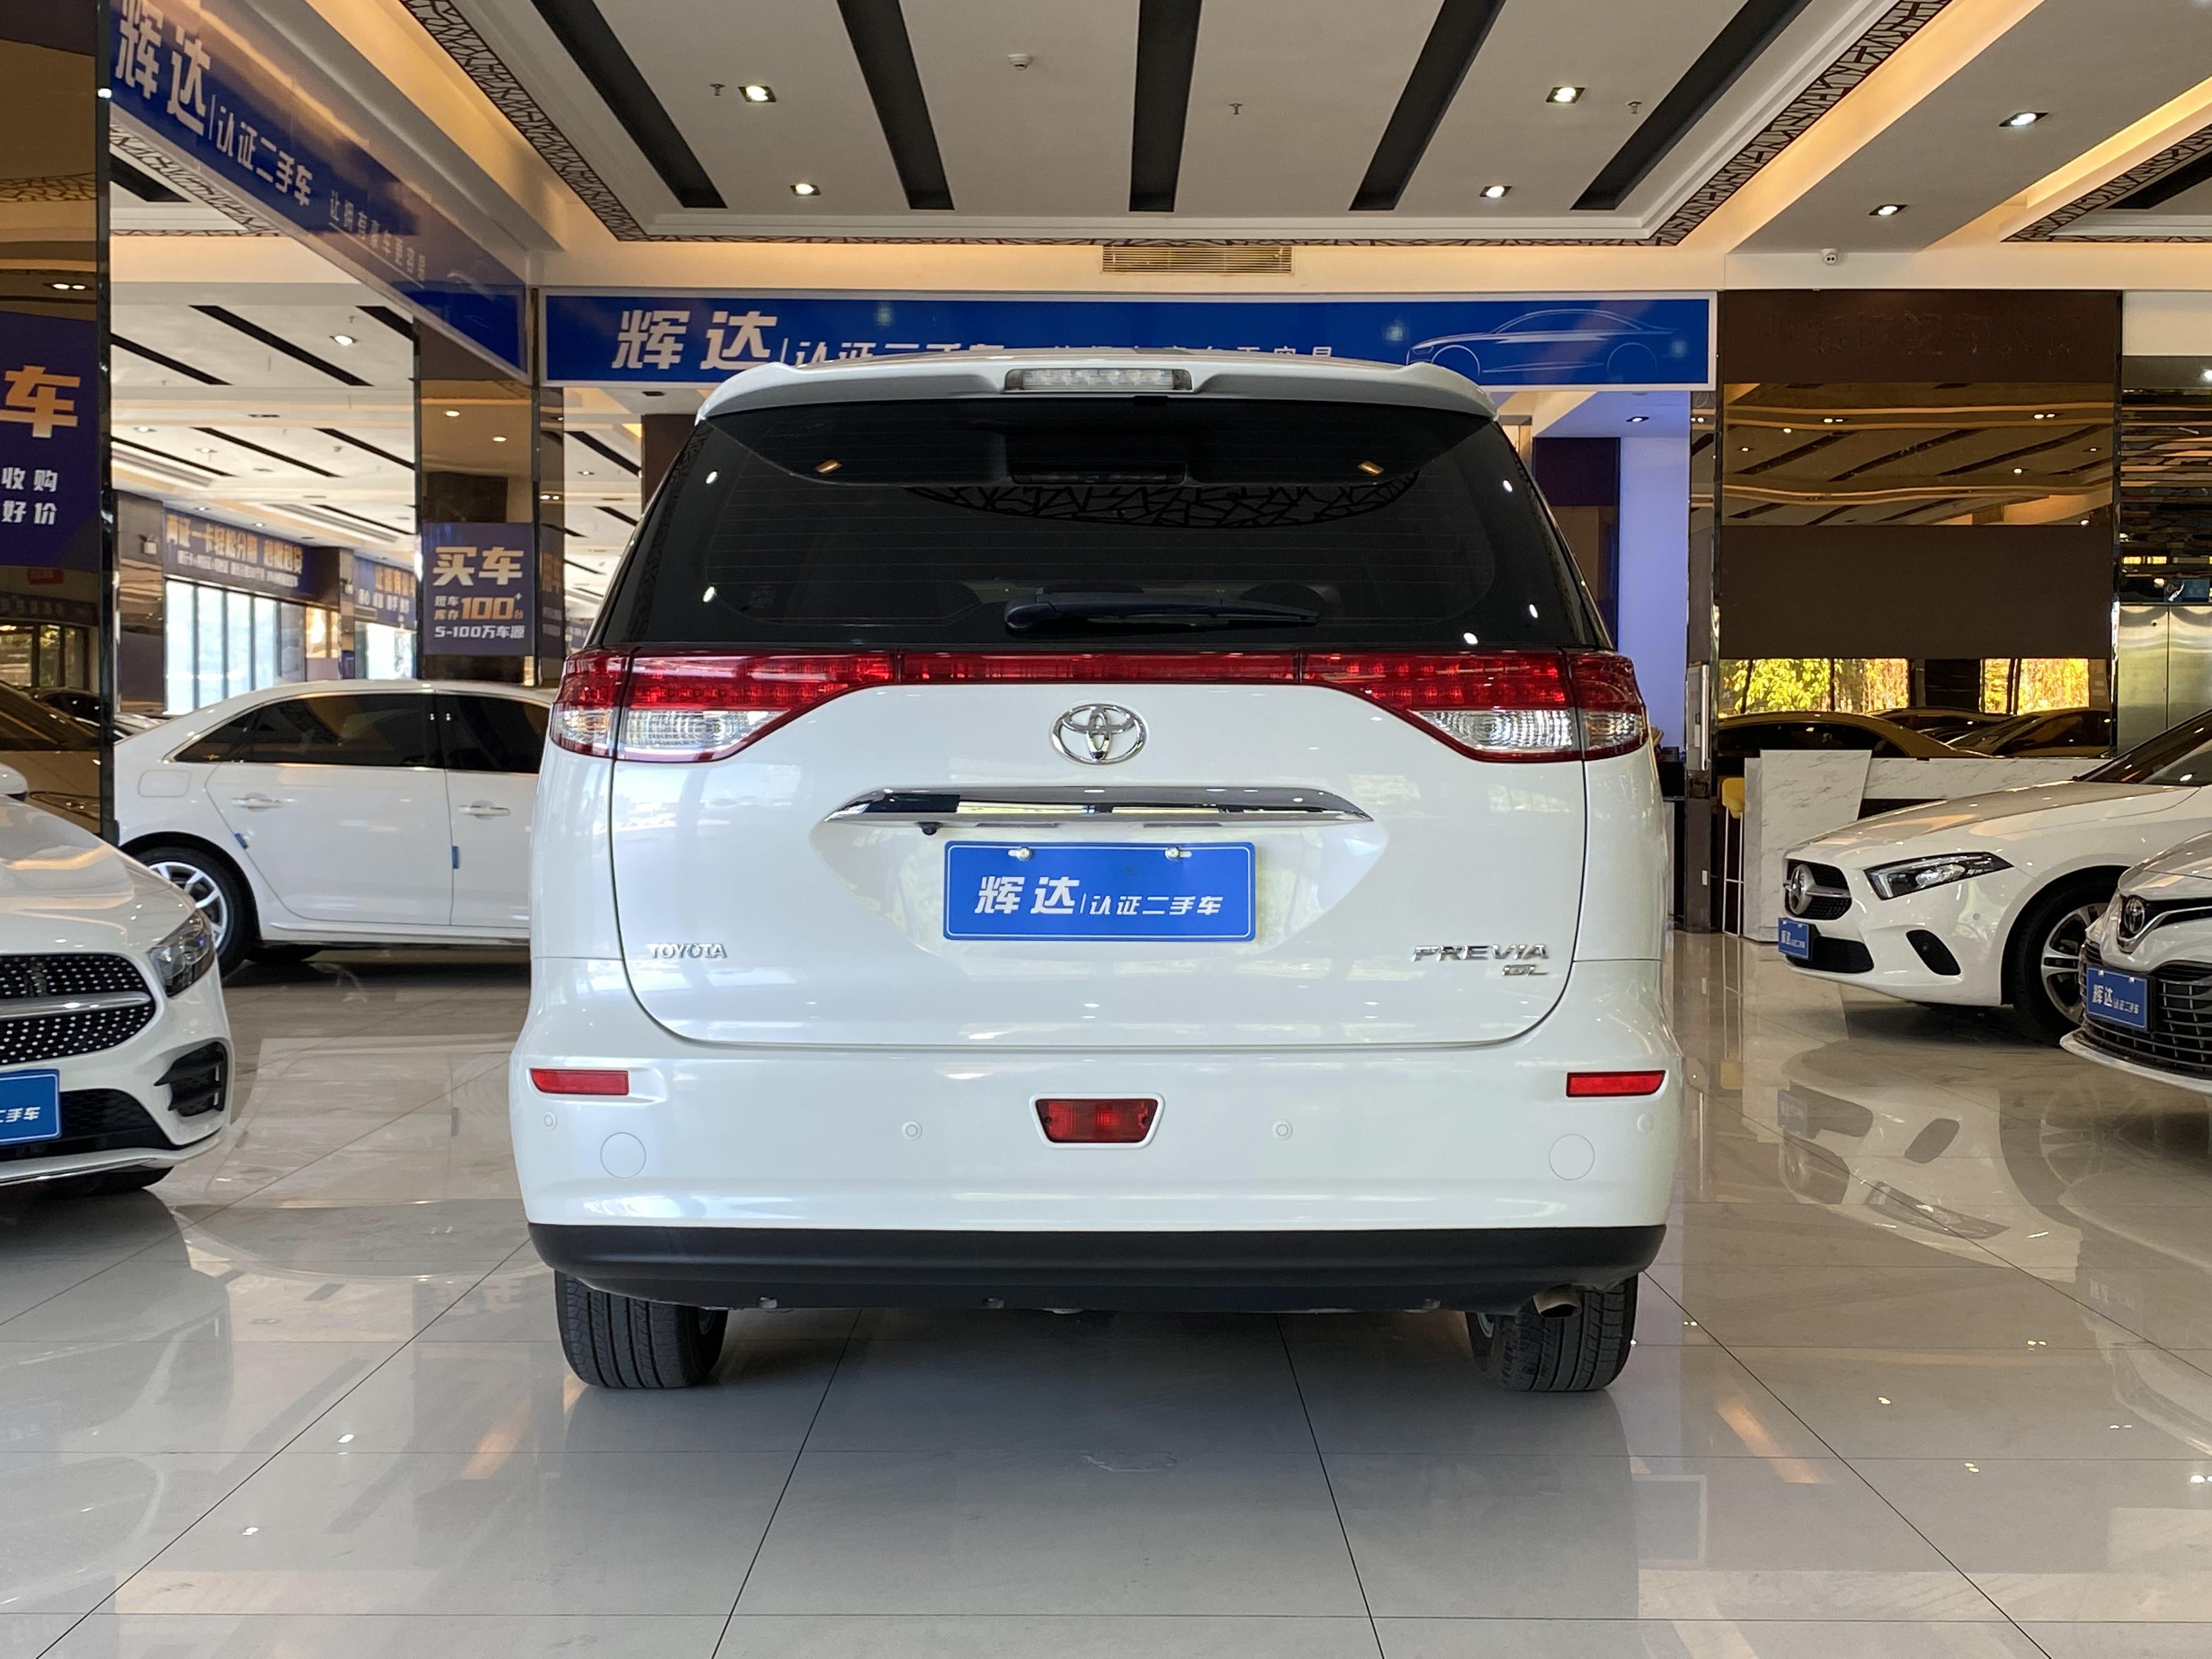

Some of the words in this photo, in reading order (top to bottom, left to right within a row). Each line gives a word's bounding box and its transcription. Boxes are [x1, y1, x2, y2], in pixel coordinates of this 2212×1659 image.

[611, 310, 778, 370] 辉达
[0, 365, 81, 438] 车
[2, 467, 58, 492] 收购
[2, 500, 57, 525] 好价
[433, 546, 524, 586] 买车
[974, 876, 1079, 915] 辉达
[1089, 895, 1223, 916] 认证二手车
[646, 943, 727, 958] TOYOTA
[1410, 944, 1549, 962] PREVIA
